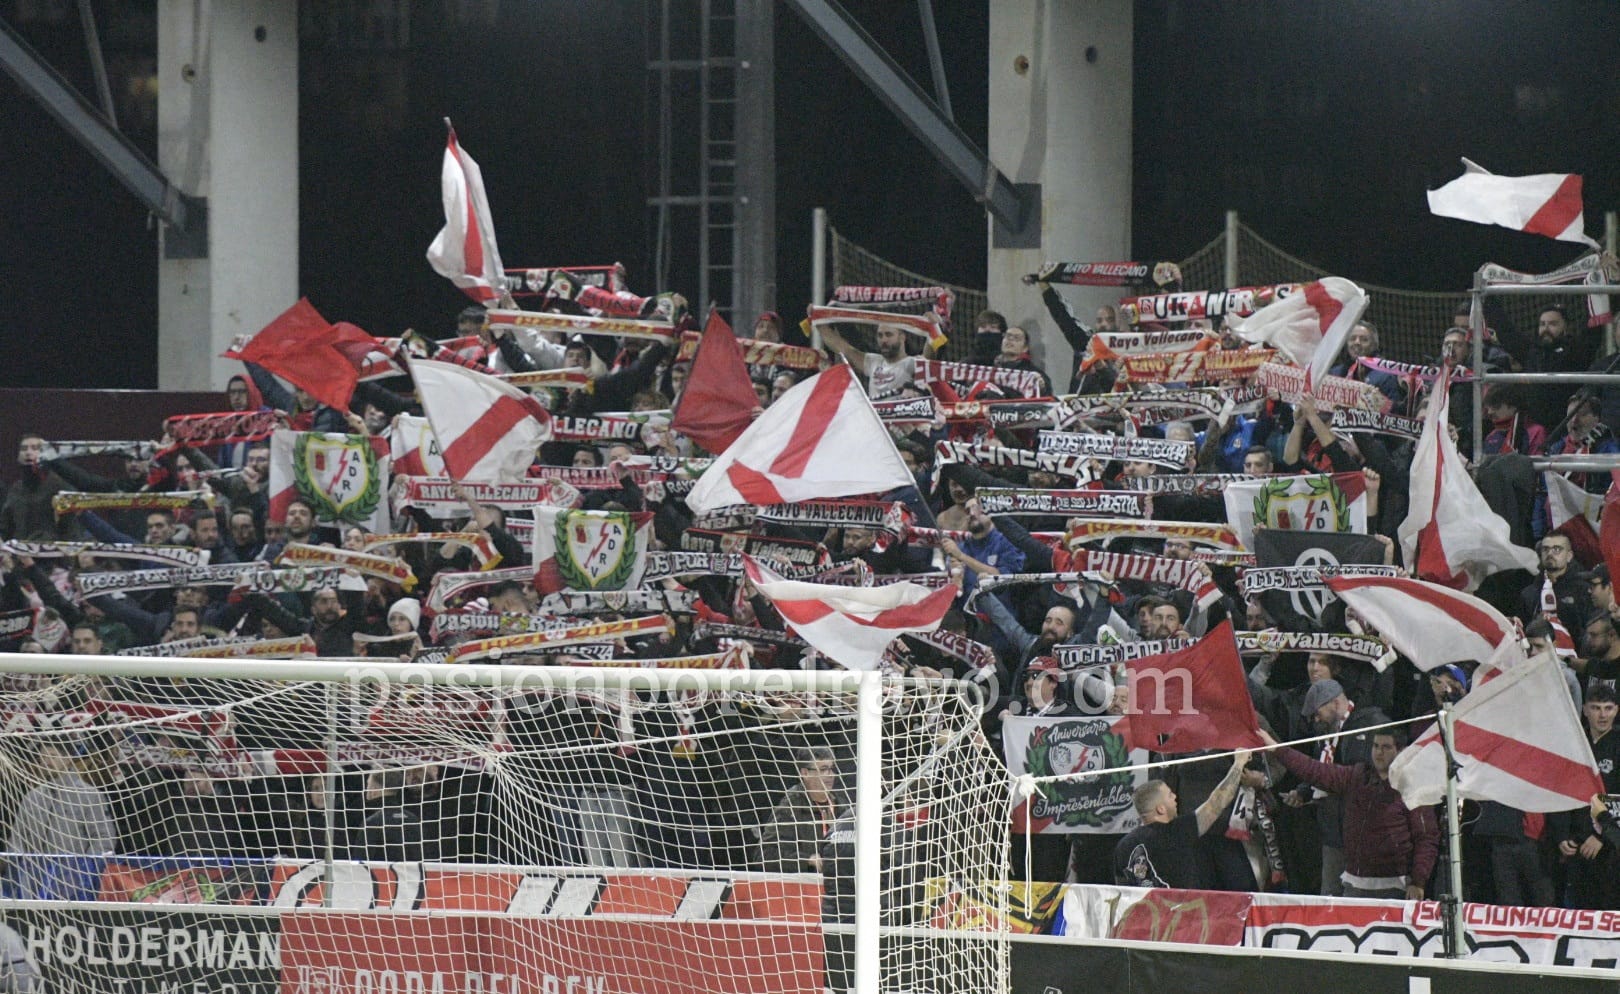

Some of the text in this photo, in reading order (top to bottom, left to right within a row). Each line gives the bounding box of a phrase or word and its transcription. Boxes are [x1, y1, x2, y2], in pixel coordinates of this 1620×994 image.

[1063, 263, 1148, 278] RAYO VALLECANO
[1108, 330, 1204, 351] Rayo Vallecano
[914, 359, 937, 386] EL
[552, 415, 638, 439] LLECANO
[334, 451, 361, 504] A D R V
[420, 485, 456, 500] RAYO
[765, 503, 884, 522] RAYO VALLECANO
[1316, 500, 1330, 529] A D
[590, 524, 622, 578] A D R V
[672, 552, 710, 571] POR
[680, 532, 817, 565] Rayo Vallecano
[1087, 551, 1147, 579] PUTO
[249, 568, 342, 593] 19 24
[1244, 571, 1285, 590] OCOS
[1060, 641, 1163, 669] LOCOS POR
[1284, 631, 1383, 658] Vallecano
[1032, 721, 1109, 747] X Aniversario
[1087, 749, 1100, 770] A D
[1032, 785, 1133, 822] Impresentables
[1420, 902, 1594, 930] SCIONADOS
[27, 925, 281, 970] HOLDERMAN
